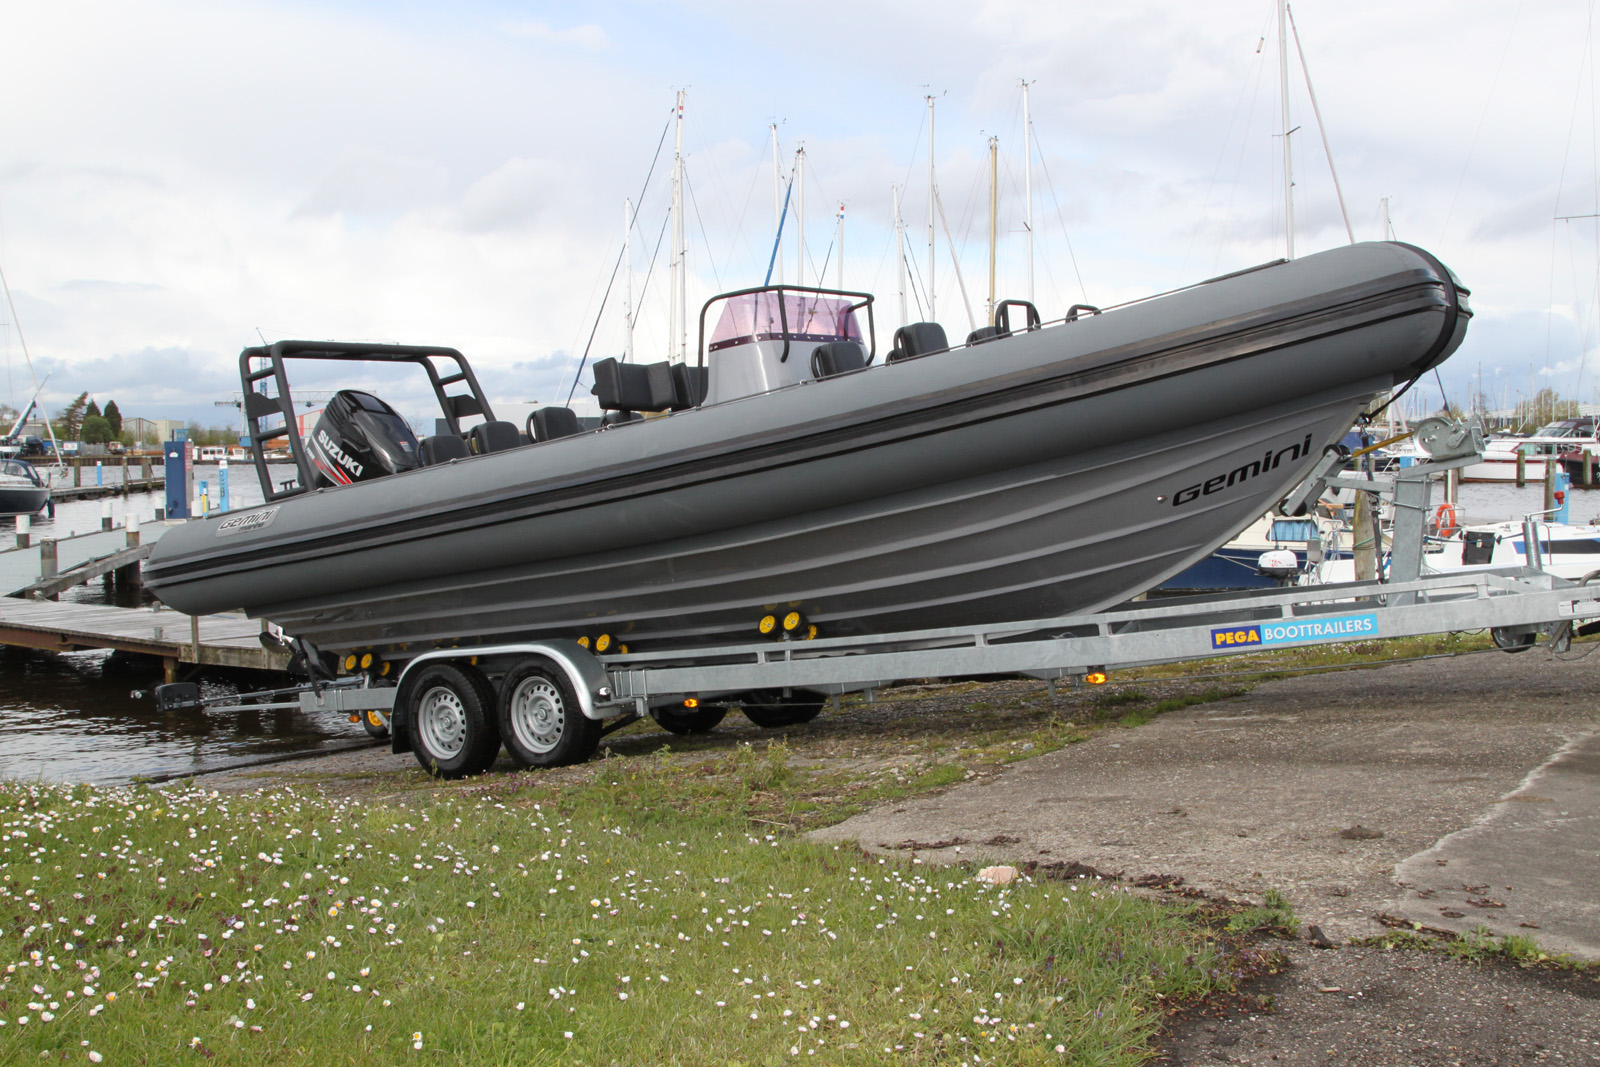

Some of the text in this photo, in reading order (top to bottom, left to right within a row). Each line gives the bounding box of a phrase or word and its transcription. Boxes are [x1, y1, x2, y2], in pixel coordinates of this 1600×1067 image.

[318, 429, 363, 477] SUZUKI
[1172, 433, 1312, 507] Gemini
[1215, 618, 1373, 646] PEGA BOOTTRAILERS
